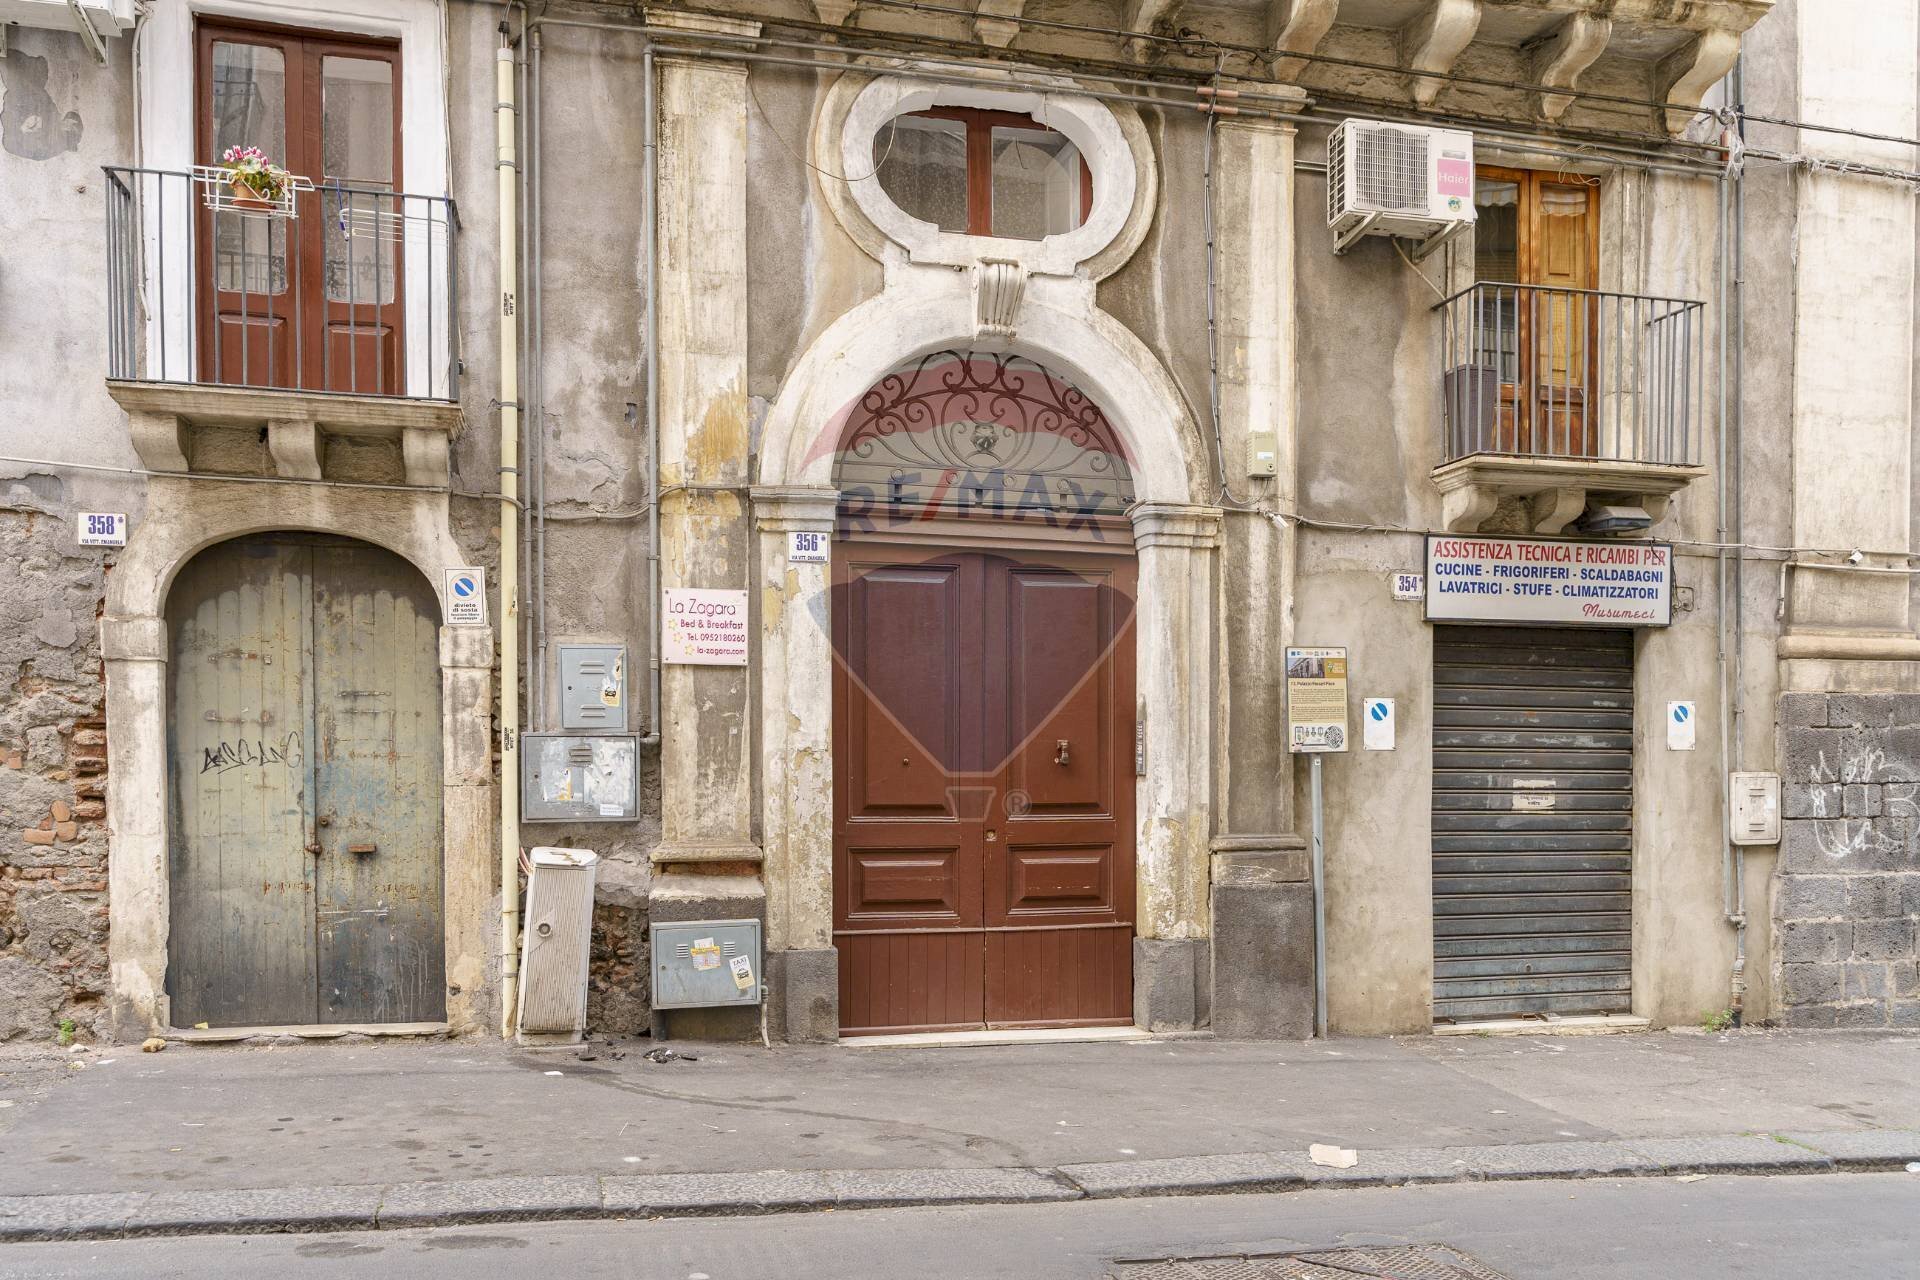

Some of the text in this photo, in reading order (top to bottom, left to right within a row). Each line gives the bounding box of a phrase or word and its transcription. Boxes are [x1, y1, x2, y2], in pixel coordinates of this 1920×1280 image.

[1438, 171, 1469, 185] Haier
[88, 515, 115, 535] 358
[796, 533, 818, 551] 356
[1433, 541, 1666, 566] ASSISTENZA TECNICA E RICAMBI PER
[1435, 563, 1482, 576] CUCINE
[1493, 565, 1569, 580] FRIGORIFERI
[1580, 568, 1663, 583] SCALDABAGNI
[1398, 575, 1418, 592] 354
[1439, 580, 1502, 594] LAVATRICI
[1513, 583, 1552, 596] STUFE
[1562, 585, 1659, 600] CLIMATIZZATORI
[669, 597, 736, 617] La Zagara
[1582, 603, 1655, 619] Musumeci
[680, 619, 743, 630] Bed & Breakfast
[700, 633, 746, 643] 0952180260
[696, 646, 745, 656] la-zagara.com
[733, 956, 747, 966] TAXI
